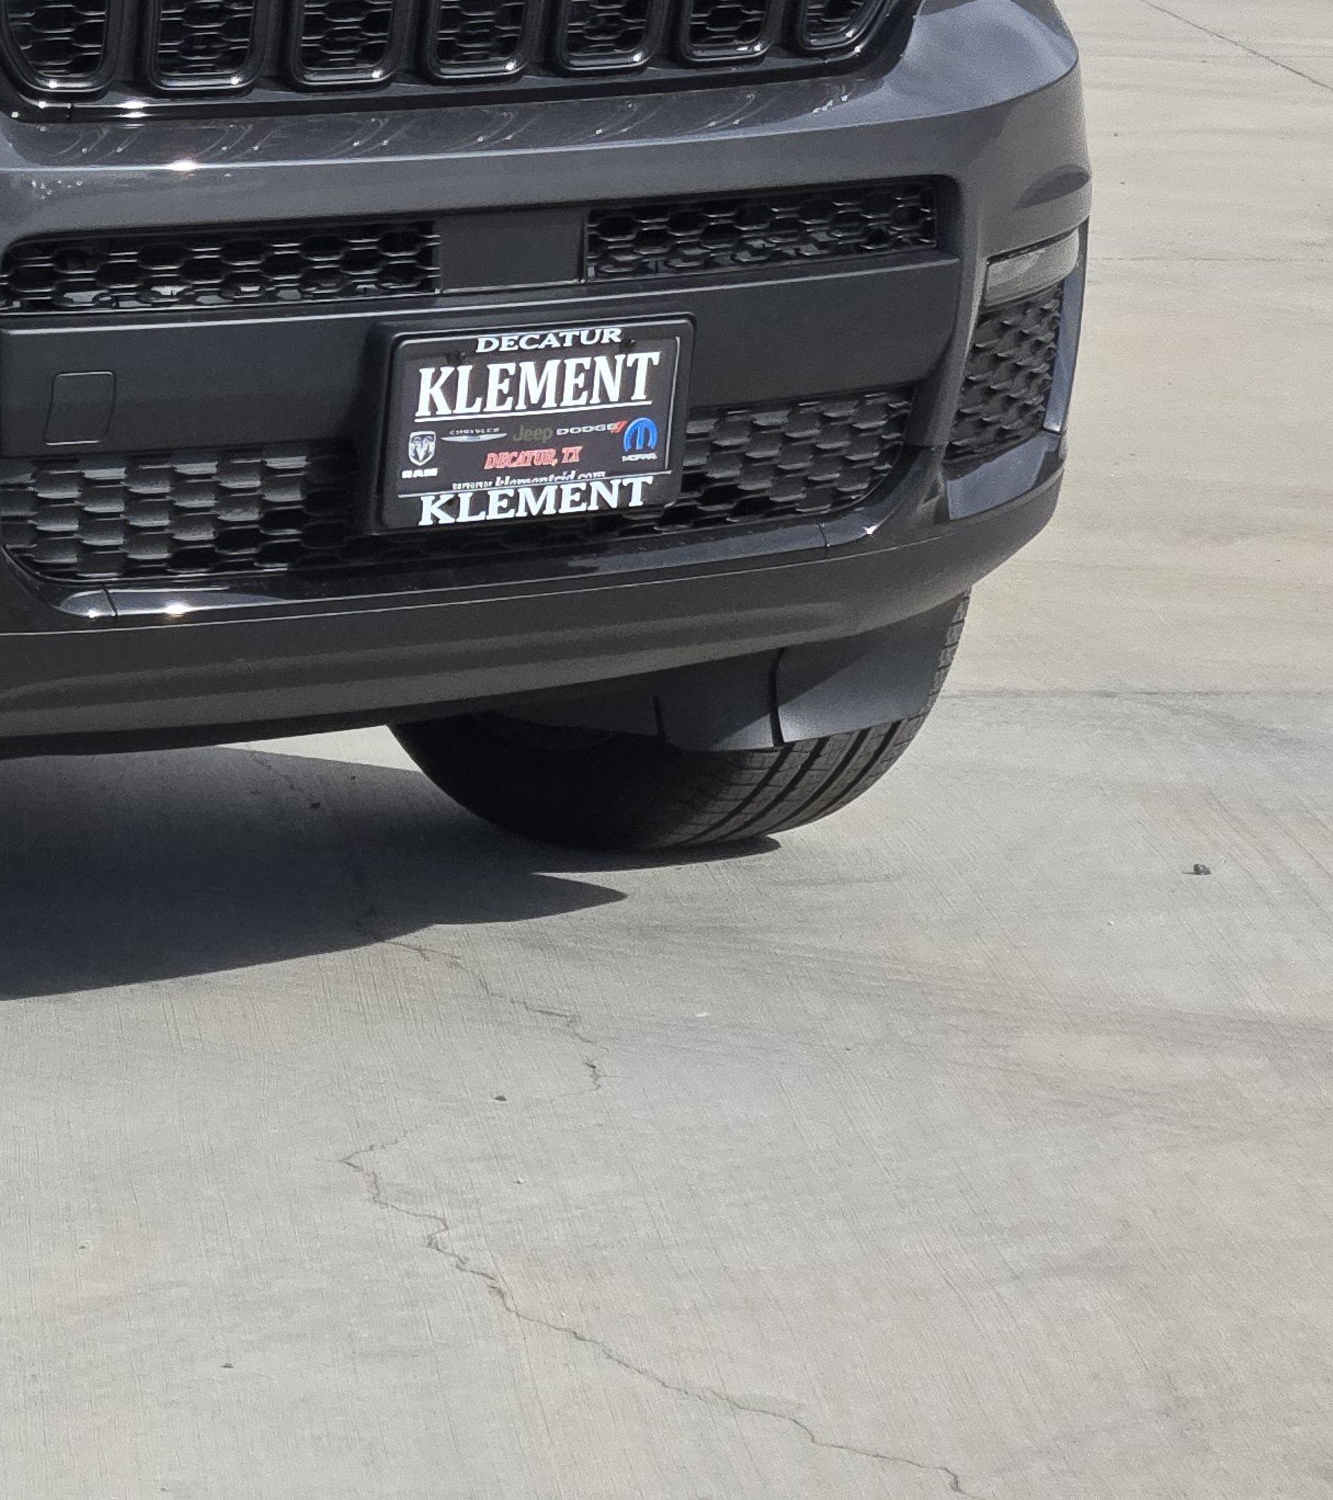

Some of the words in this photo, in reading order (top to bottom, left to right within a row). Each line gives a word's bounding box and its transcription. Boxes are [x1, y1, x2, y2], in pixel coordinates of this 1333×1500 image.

[475, 328, 623, 353] DECATUR
[415, 351, 661, 417] KLEMENT
[512, 425, 553, 443] Jeep
[556, 422, 617, 436] DODGE
[561, 446, 583, 464] TX
[401, 467, 438, 479] RAM
[418, 475, 654, 526] KLEMENT
